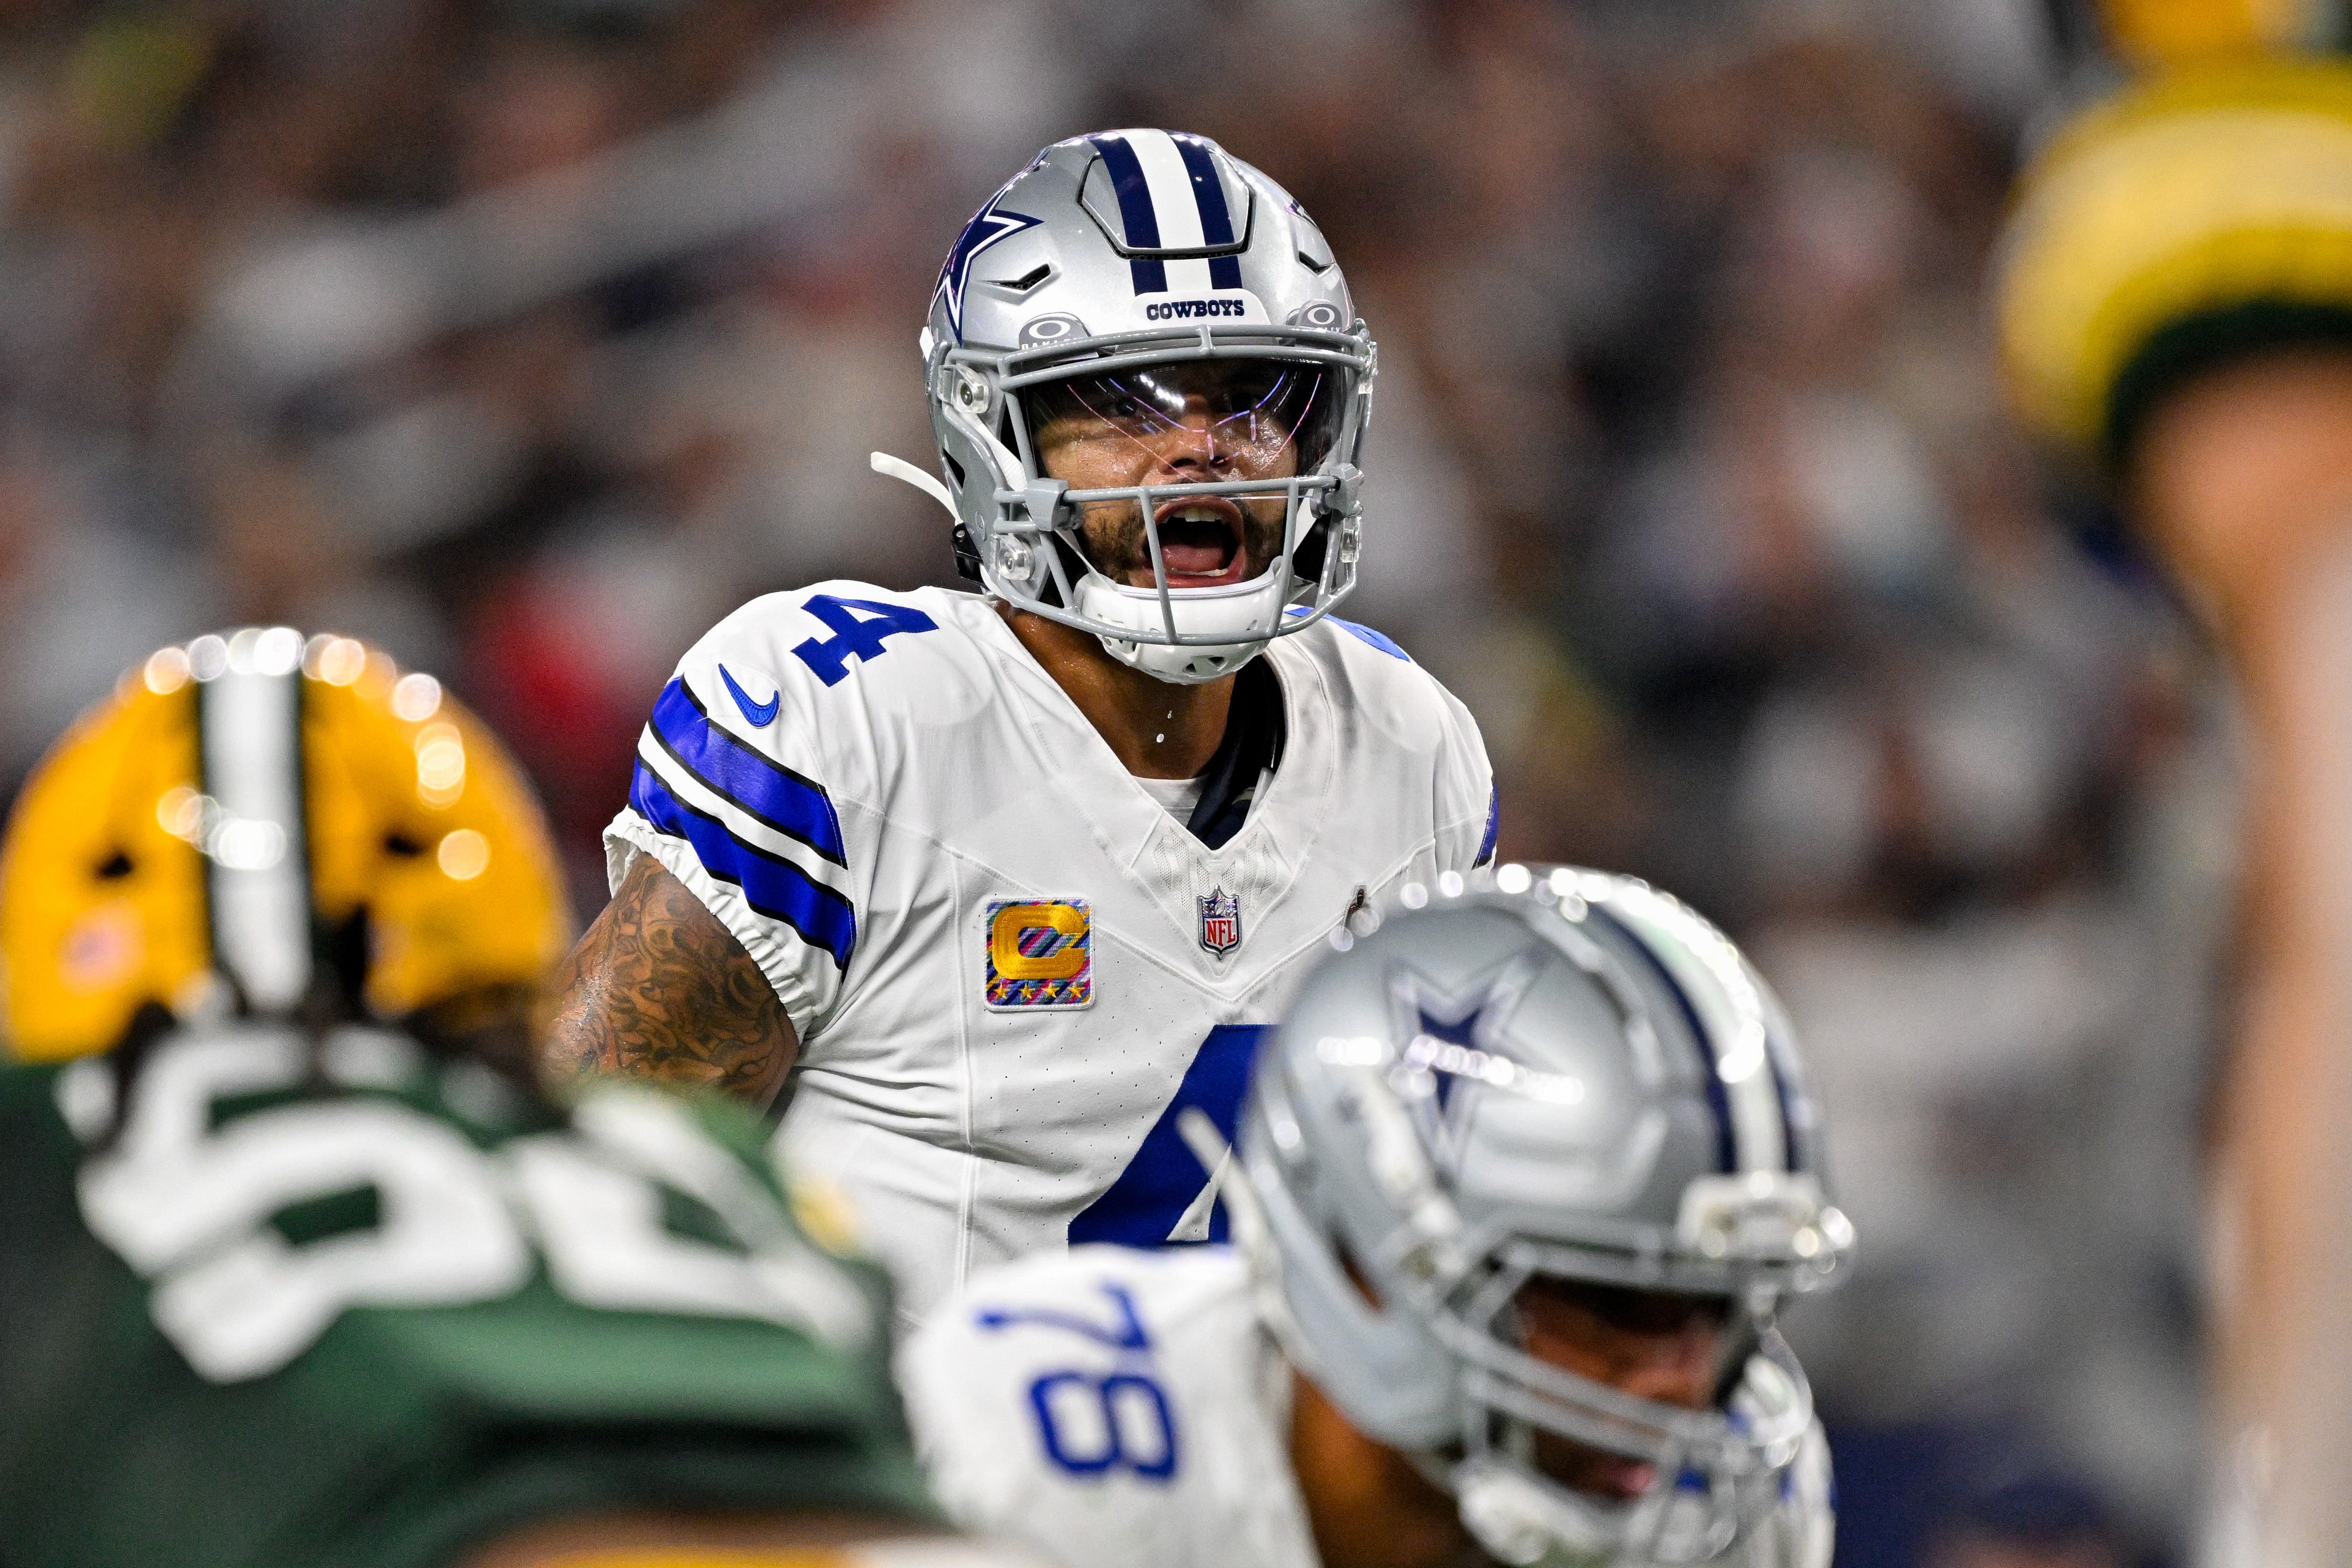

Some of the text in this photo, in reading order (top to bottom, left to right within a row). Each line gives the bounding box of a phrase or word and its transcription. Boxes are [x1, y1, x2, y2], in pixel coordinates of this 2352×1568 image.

[1146, 300, 1245, 321] COWBOYS
[790, 594, 939, 688] 4
[992, 905, 1085, 980] C
[1205, 919, 1236, 947] NFL
[975, 1278, 1178, 1480] 78
